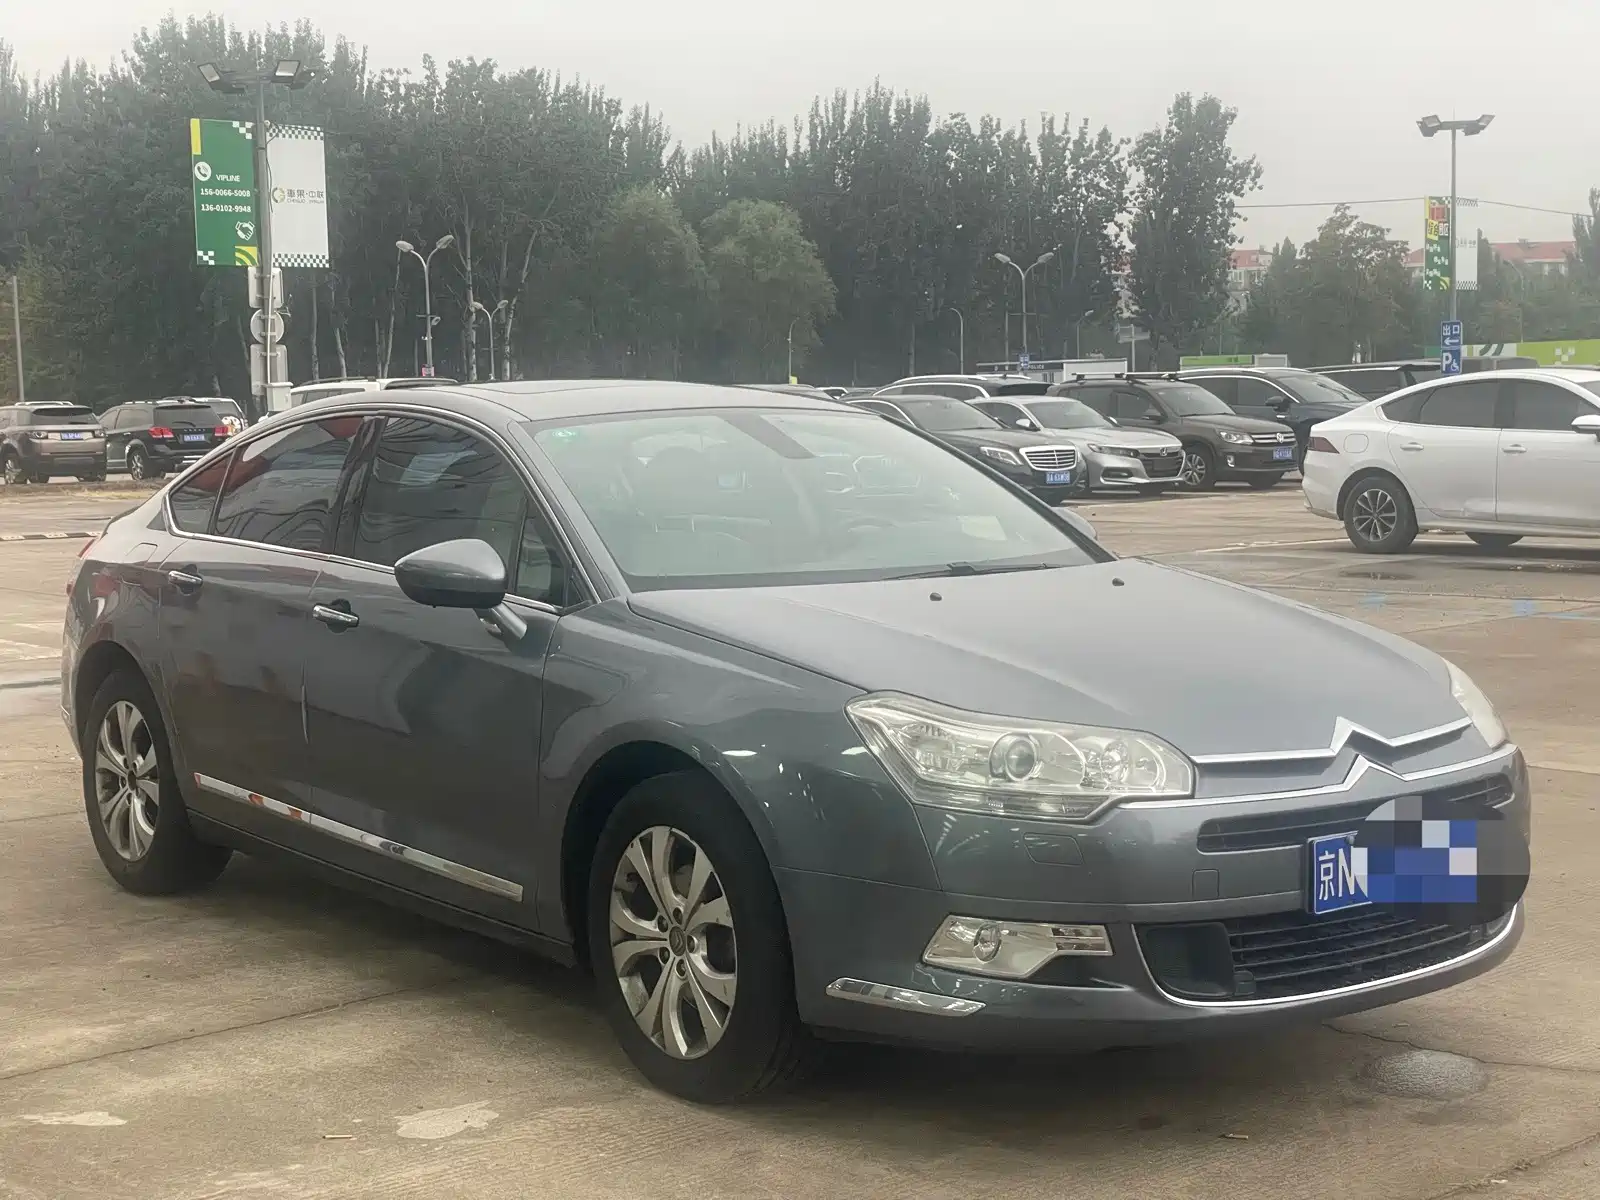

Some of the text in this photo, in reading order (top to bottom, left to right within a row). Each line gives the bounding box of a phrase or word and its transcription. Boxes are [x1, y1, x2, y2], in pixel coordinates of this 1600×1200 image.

[216, 174, 240, 182] VIPLINE
[201, 204, 251, 212] 136-0102-9948
[1443, 324, 1460, 336] 出口
[1442, 352, 1452, 371] P
